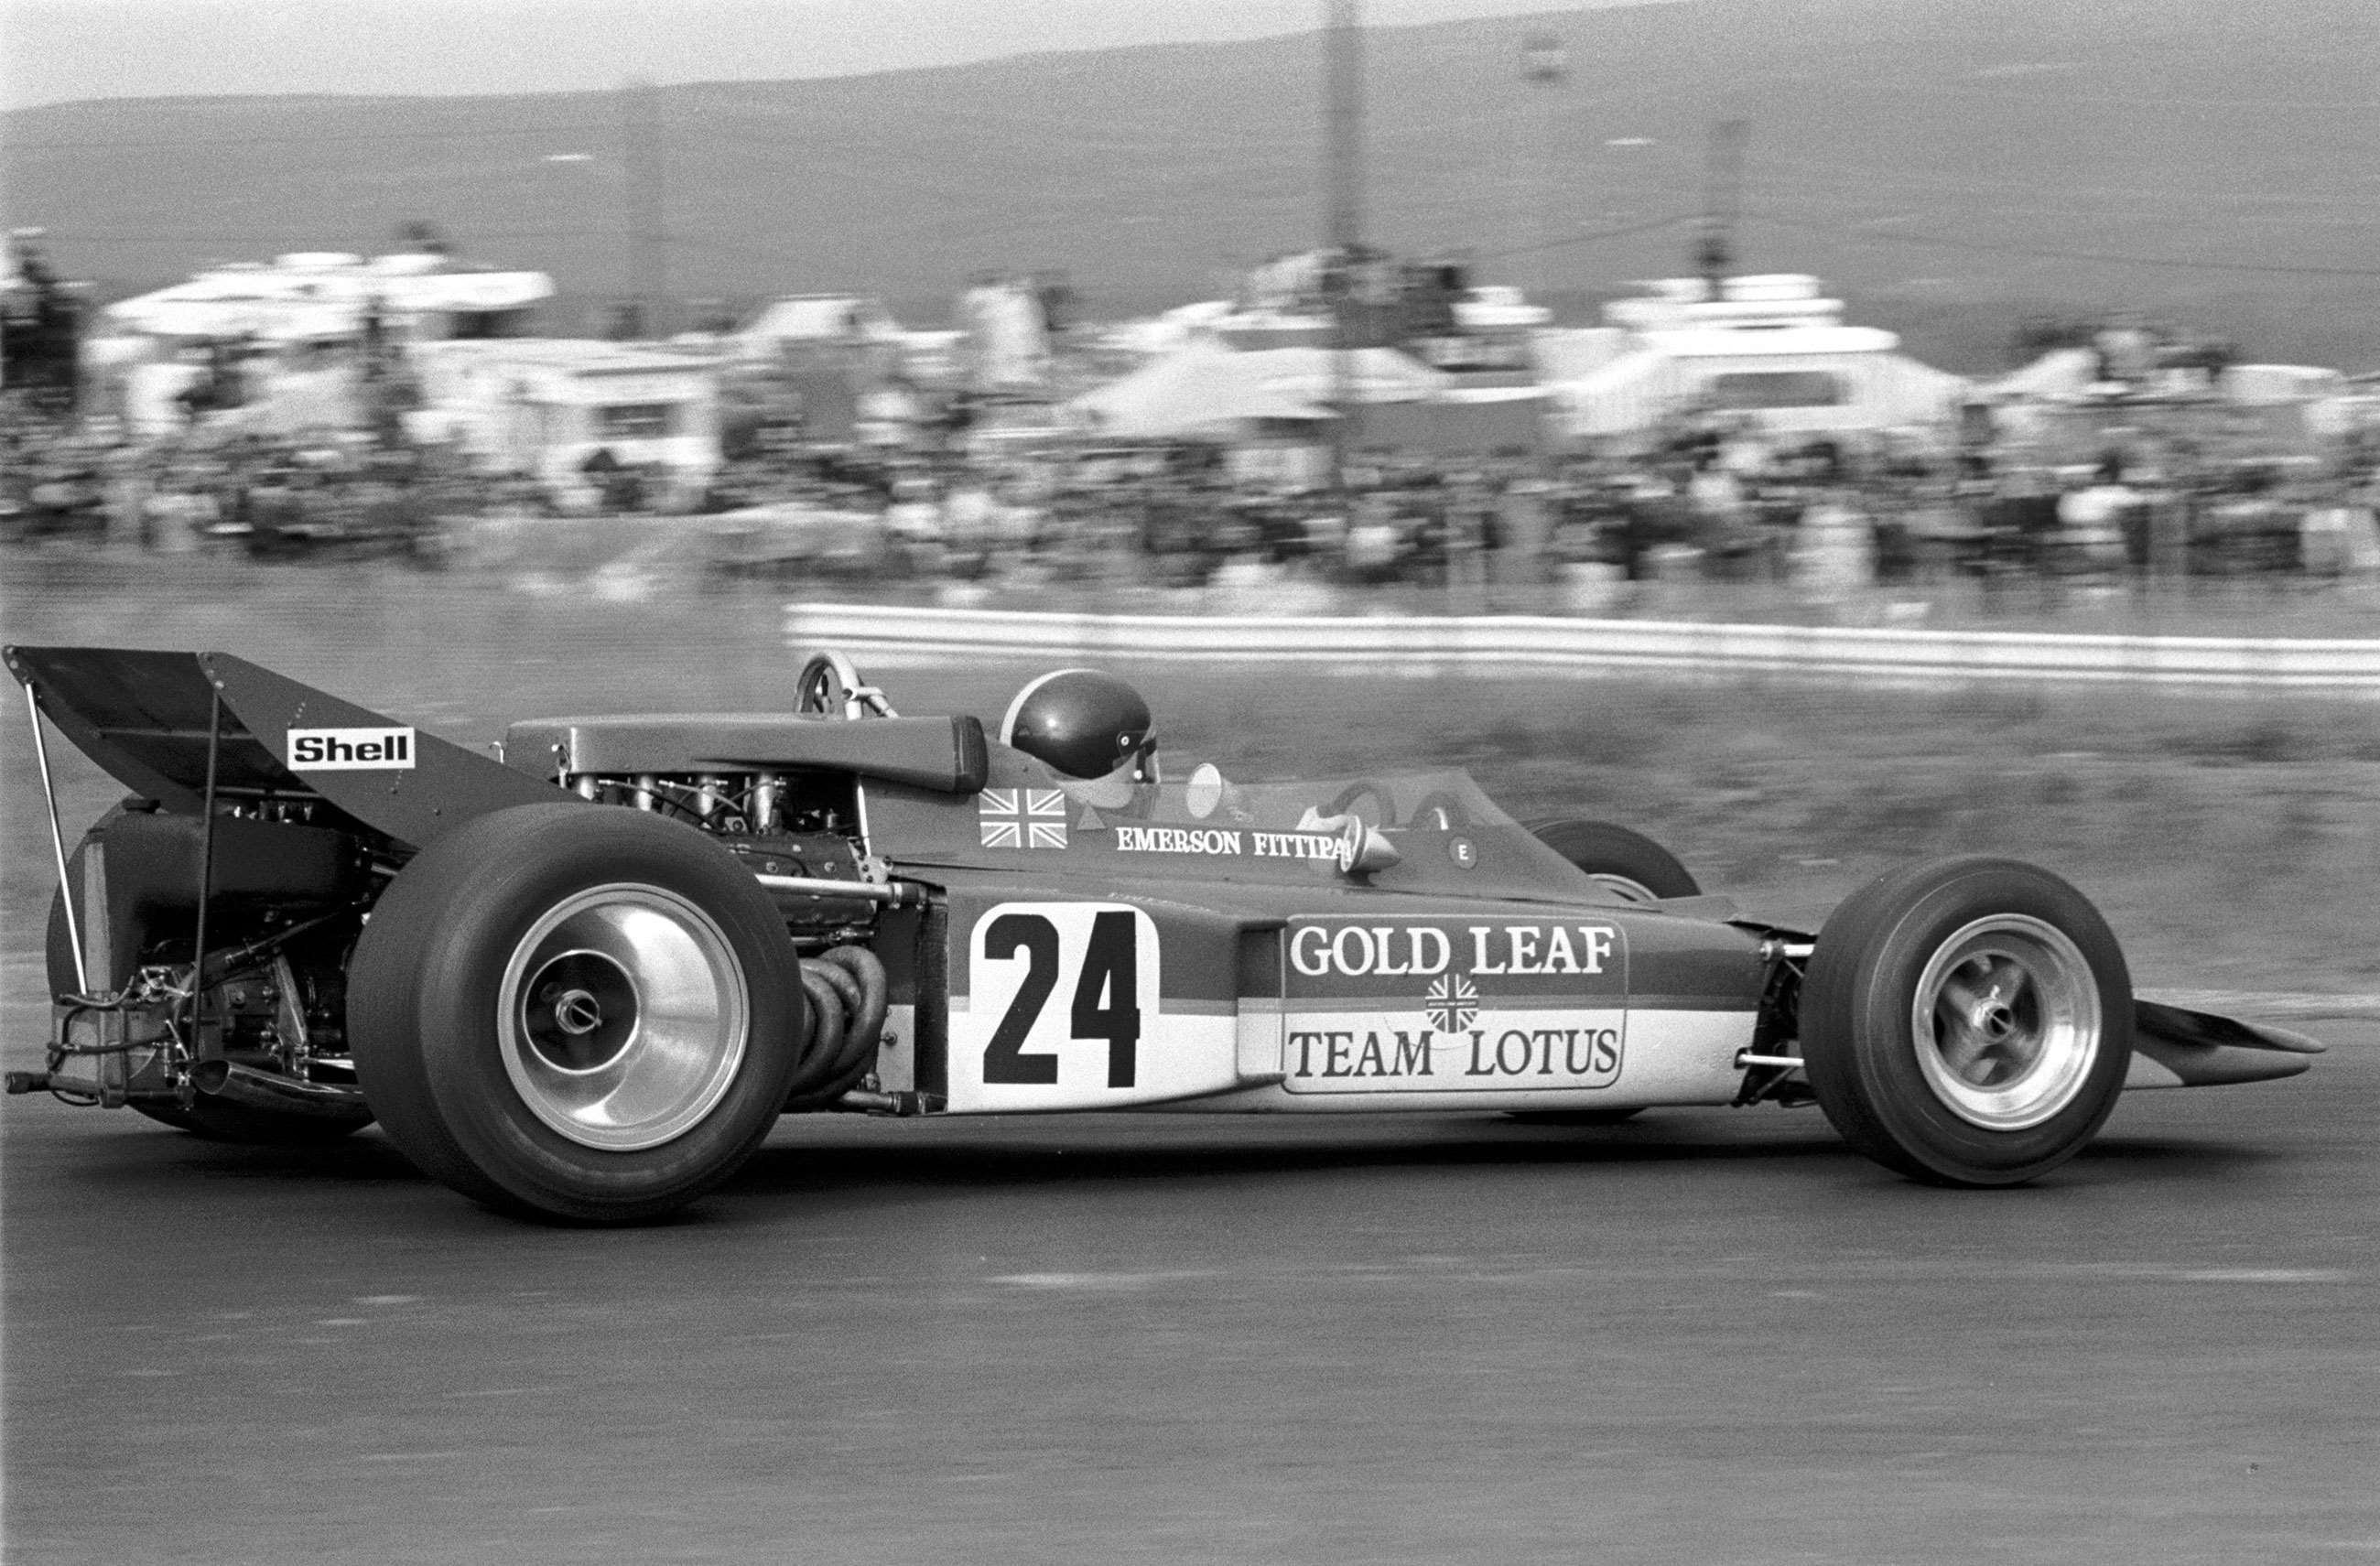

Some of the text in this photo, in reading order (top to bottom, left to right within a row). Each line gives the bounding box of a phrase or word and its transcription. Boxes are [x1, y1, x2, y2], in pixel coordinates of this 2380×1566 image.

[294, 735, 408, 762] Shell
[1115, 826, 1342, 859] EMERSON FITTIPA
[1458, 844, 1469, 860] E
[1290, 925, 1616, 976] GOLD LEAF
[982, 911, 1141, 1088] 24
[1288, 1029, 1617, 1078] TEAM LOTUS
